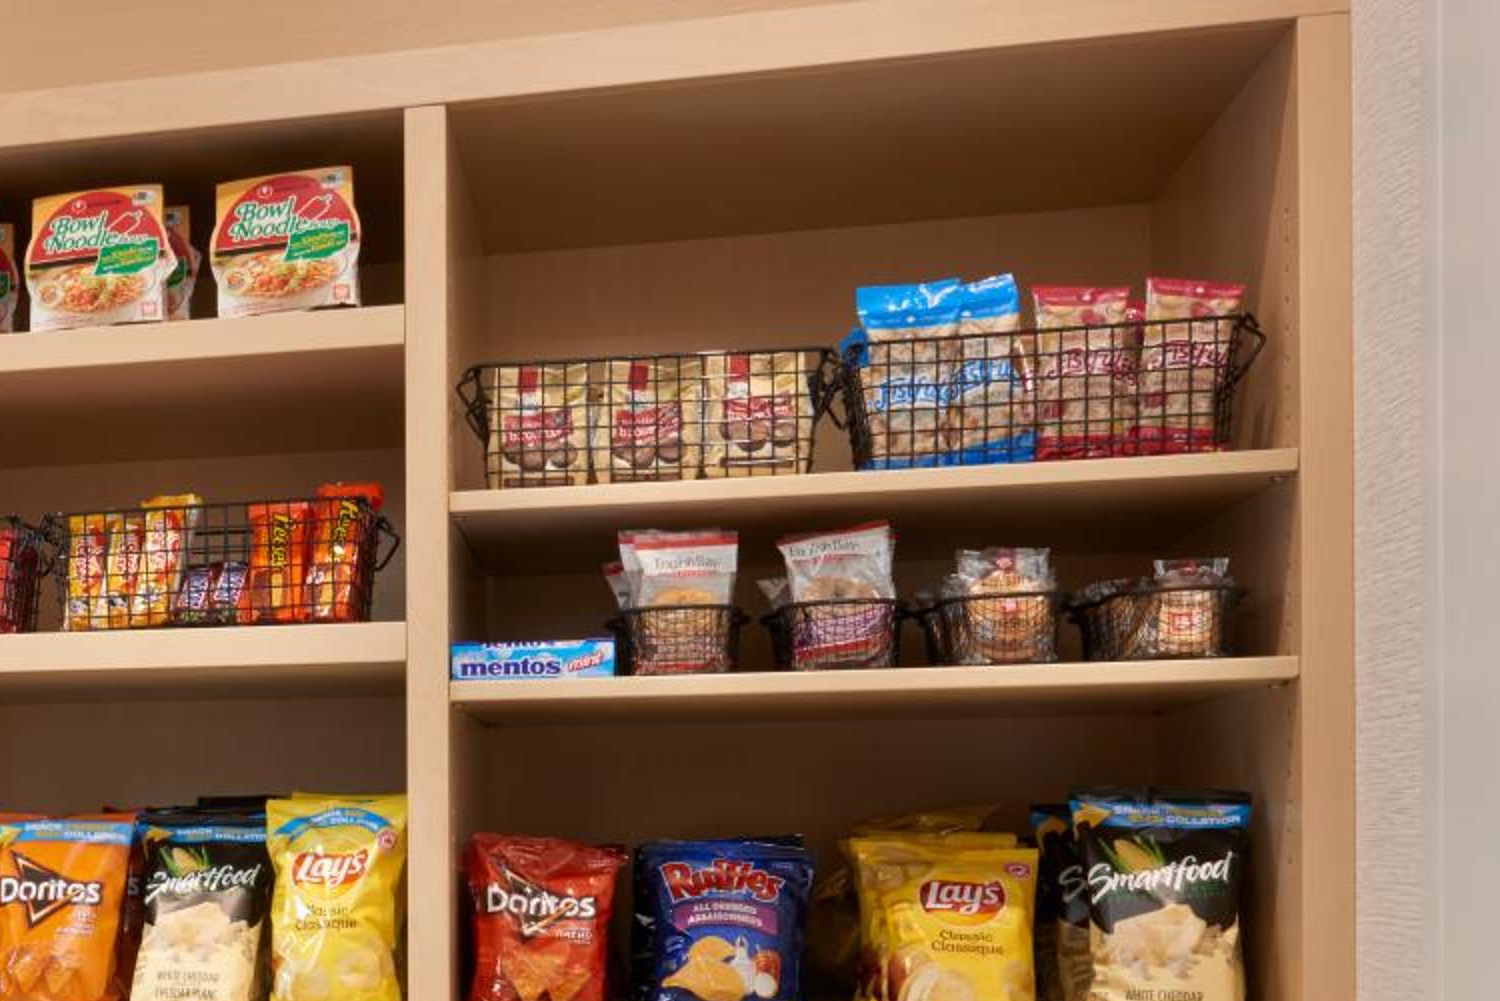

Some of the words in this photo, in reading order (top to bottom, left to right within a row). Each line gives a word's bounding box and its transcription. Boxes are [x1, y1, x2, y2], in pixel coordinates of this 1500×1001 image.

[51, 209, 107, 234] Bowl
[235, 194, 296, 222] Bowl
[45, 226, 118, 255] Noodle
[229, 214, 307, 242] Noodle
[459, 658, 562, 676] mentos
[0, 876, 102, 906] Doritos
[145, 864, 261, 905] Smartfood
[660, 858, 786, 903] Ruffles
[1088, 851, 1233, 904] Smartfood
[486, 881, 597, 919] Doritos
